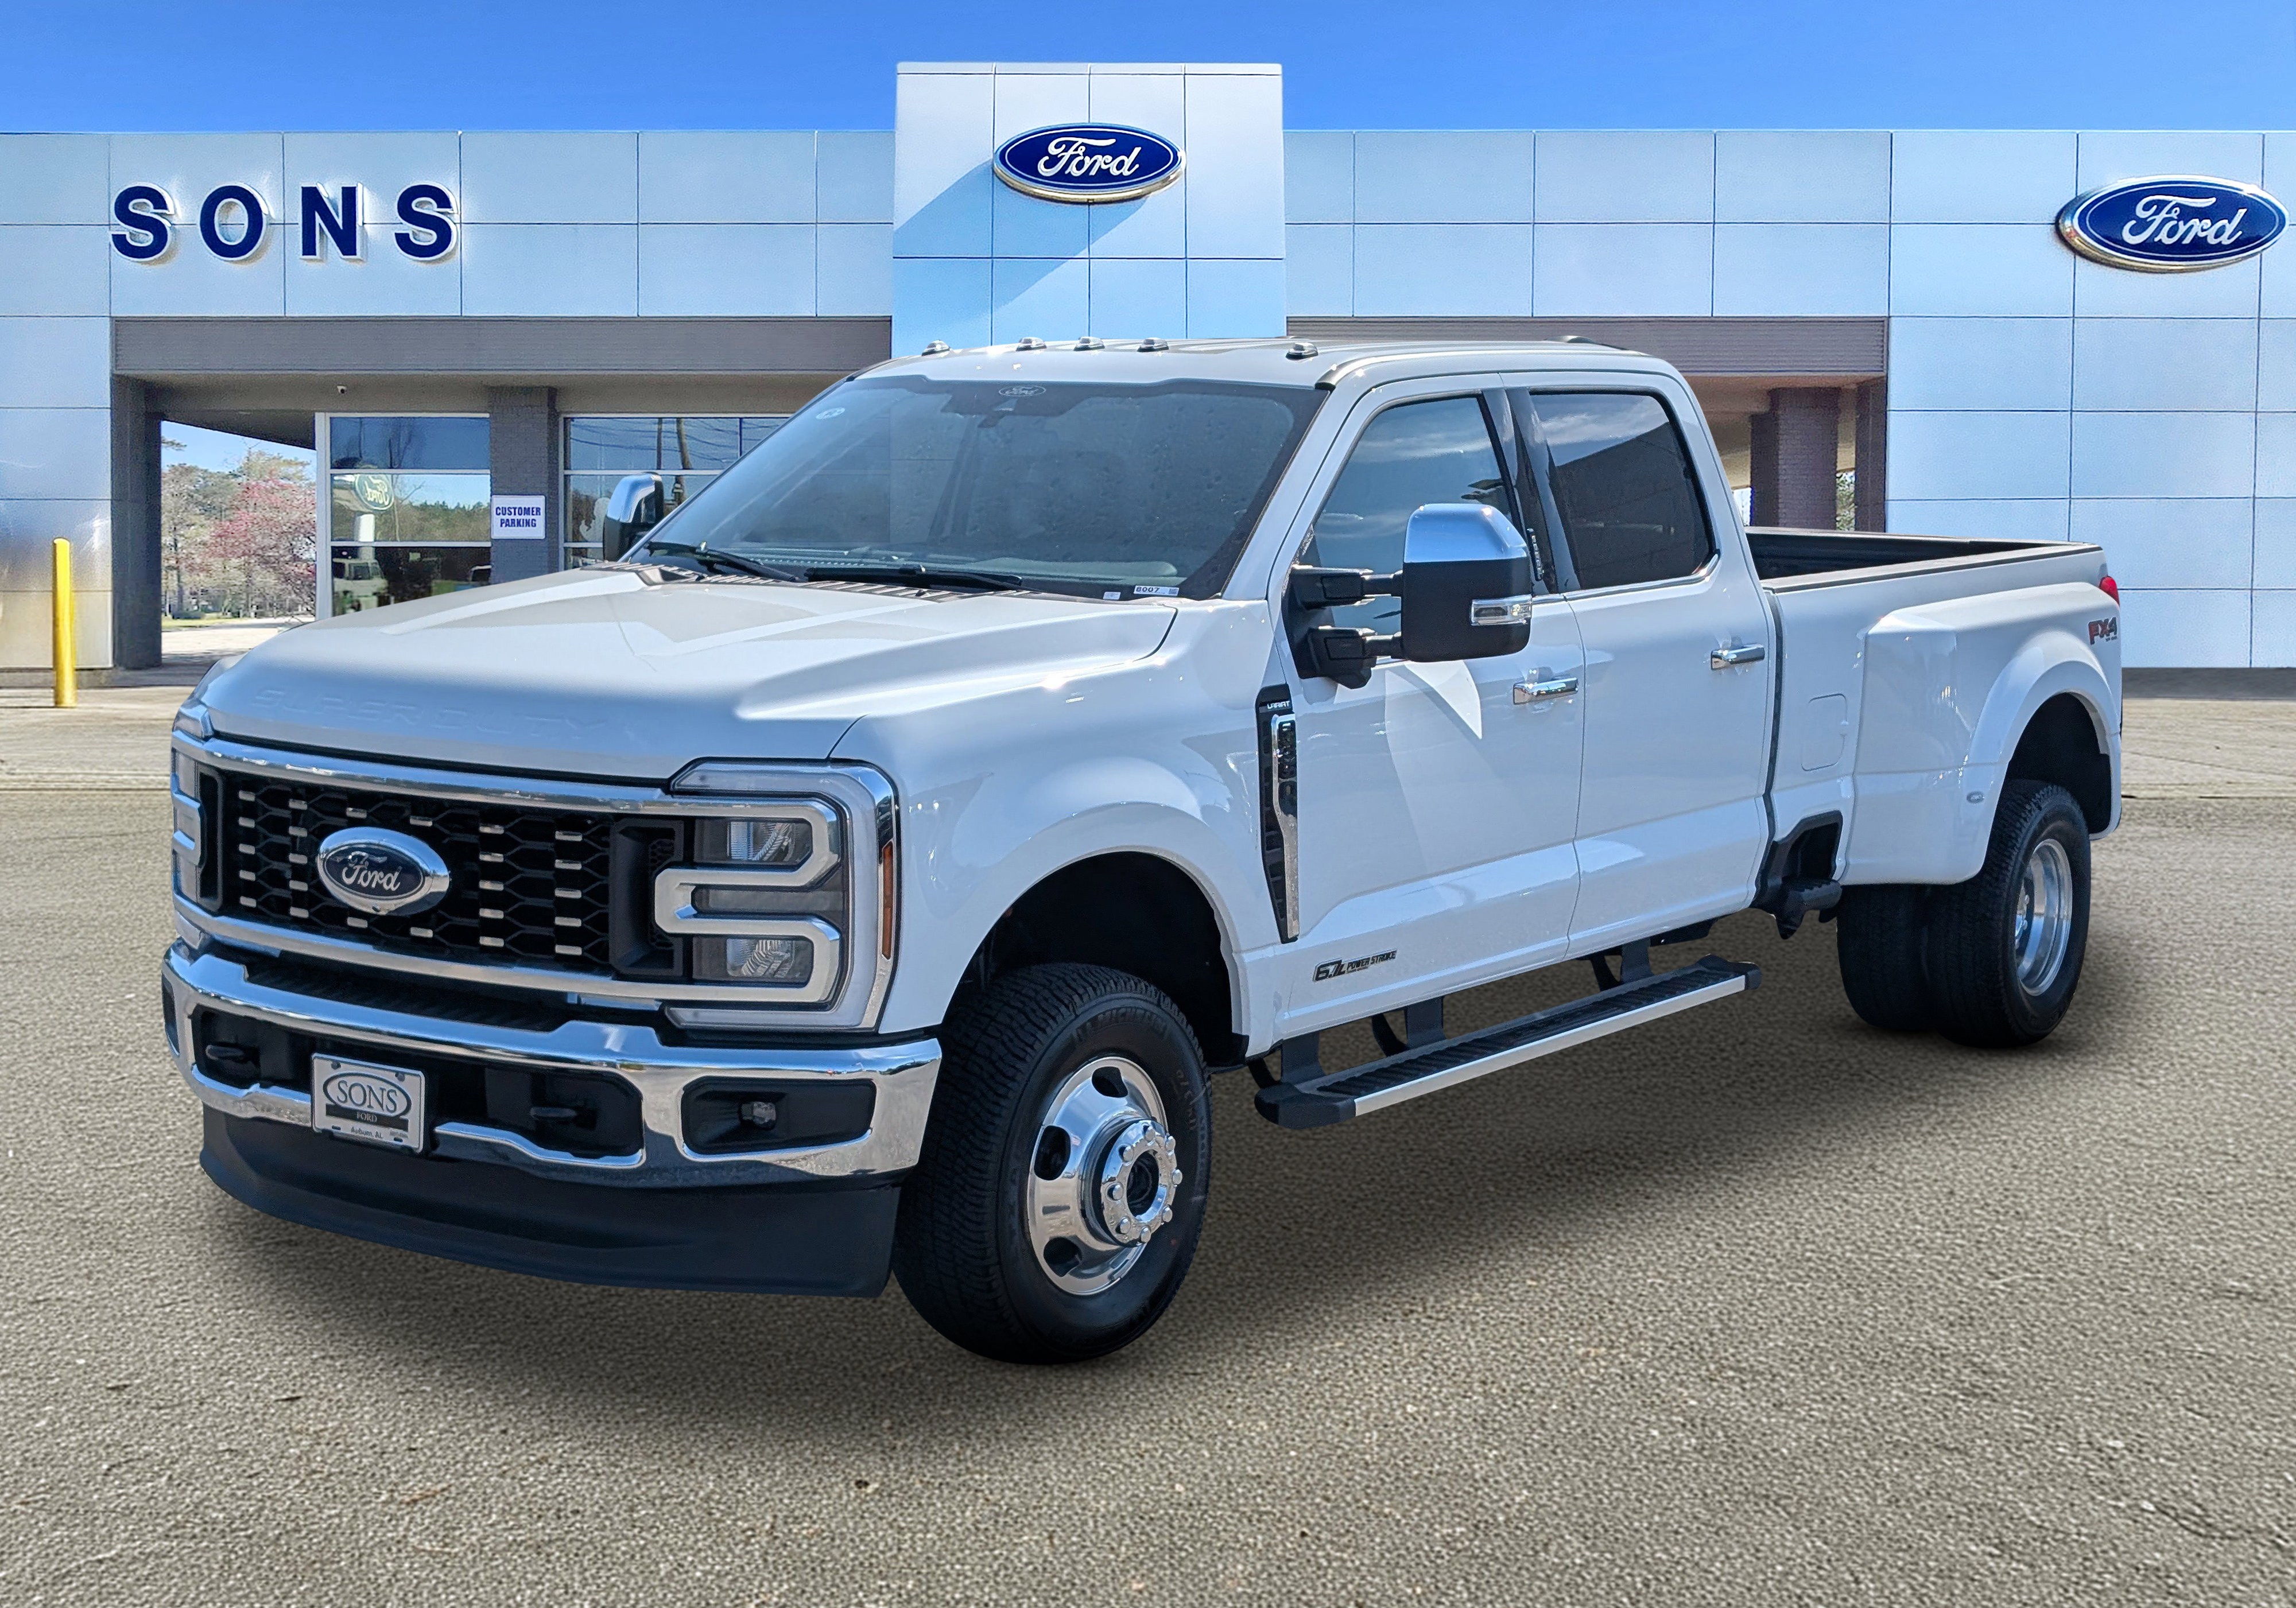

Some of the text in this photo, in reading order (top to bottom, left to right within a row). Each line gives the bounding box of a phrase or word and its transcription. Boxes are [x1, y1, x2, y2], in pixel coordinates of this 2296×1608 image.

[1037, 136, 1142, 177] Ford
[111, 184, 457, 261] SONS
[2122, 195, 2248, 245] Ford
[1005, 385, 1038, 395] Ford
[495, 507, 541, 515] CUSTOMER
[500, 519, 537, 527] PARKING
[2088, 617, 2117, 645] FX4
[342, 850, 402, 891] Ford
[1314, 960, 1345, 981] 6.7L
[1347, 957, 1370, 970] POWER
[1371, 950, 1397, 965] STROKE
[336, 1079, 398, 1113] SONS
[356, 1111, 378, 1123] FORD
